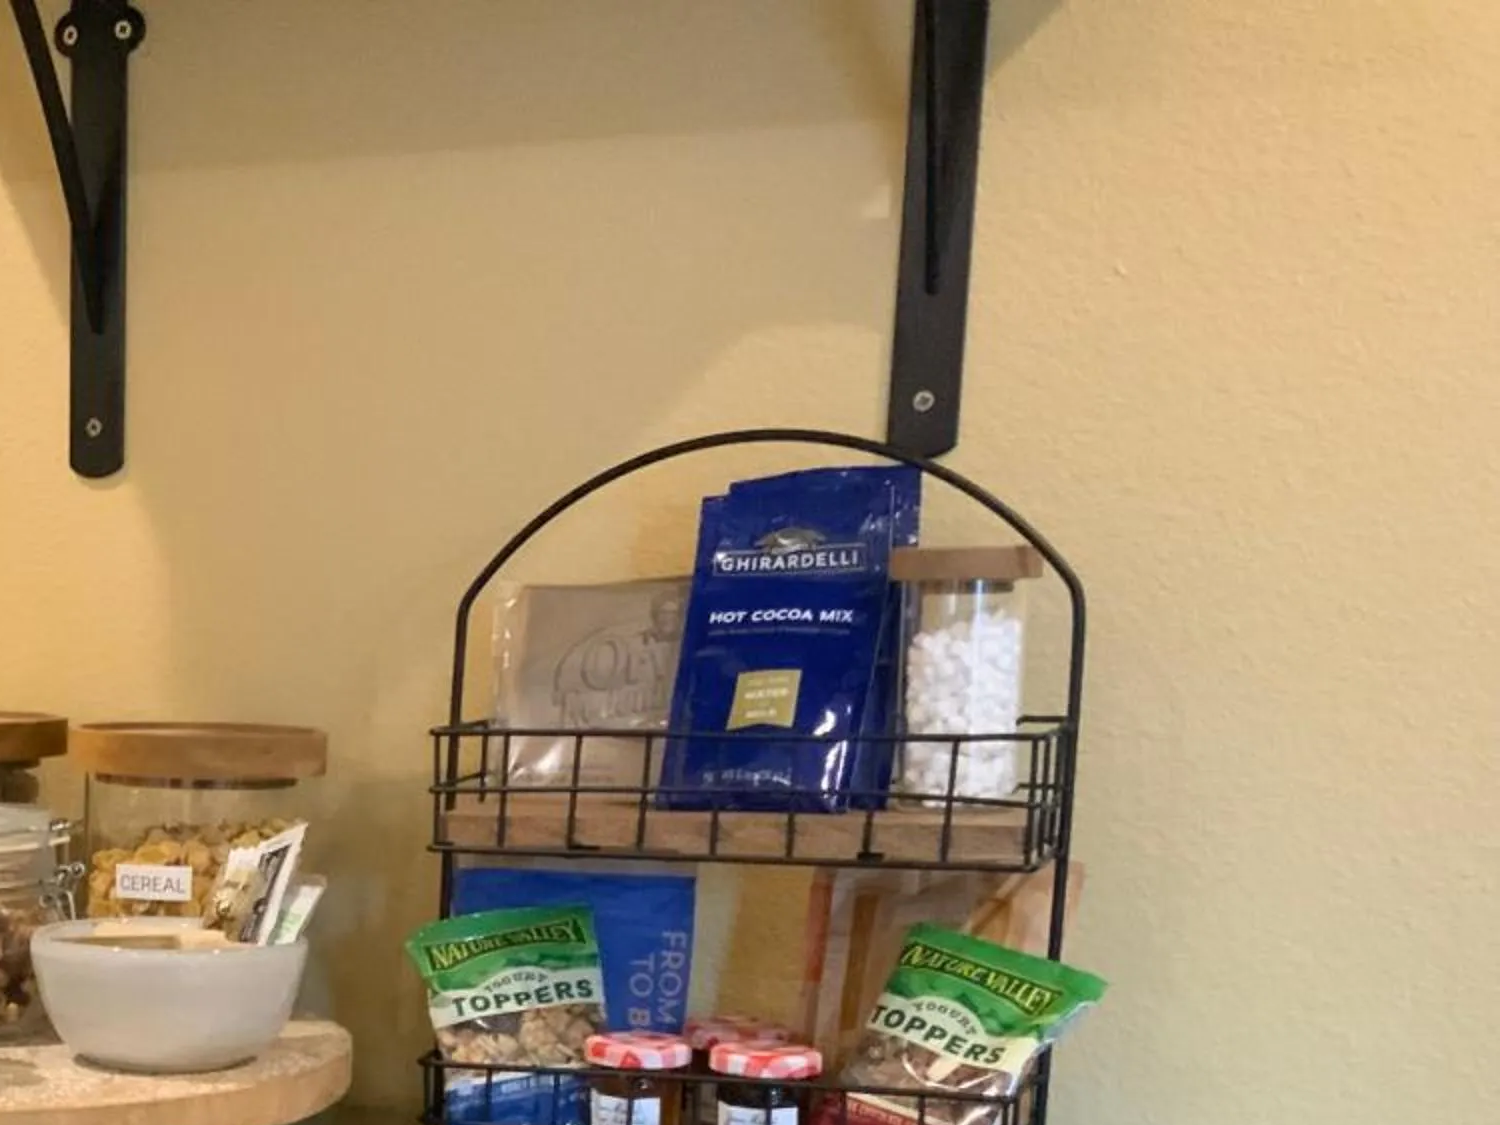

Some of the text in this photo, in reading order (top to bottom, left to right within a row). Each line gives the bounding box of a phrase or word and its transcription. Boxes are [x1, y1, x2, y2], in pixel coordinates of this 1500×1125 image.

[719, 550, 859, 572] GHIRARDELLI
[708, 607, 853, 625] HOT COCOA MIX
[120, 873, 186, 894] CEREAL
[431, 936, 505, 969] NATURE
[900, 945, 985, 985] NATURE
[628, 951, 655, 998] TO
[657, 930, 687, 1025] FROM
[452, 978, 594, 1017] TOPPERS
[870, 1005, 1007, 1065] TOPPERS
[912, 1000, 978, 1036] YOGURT
